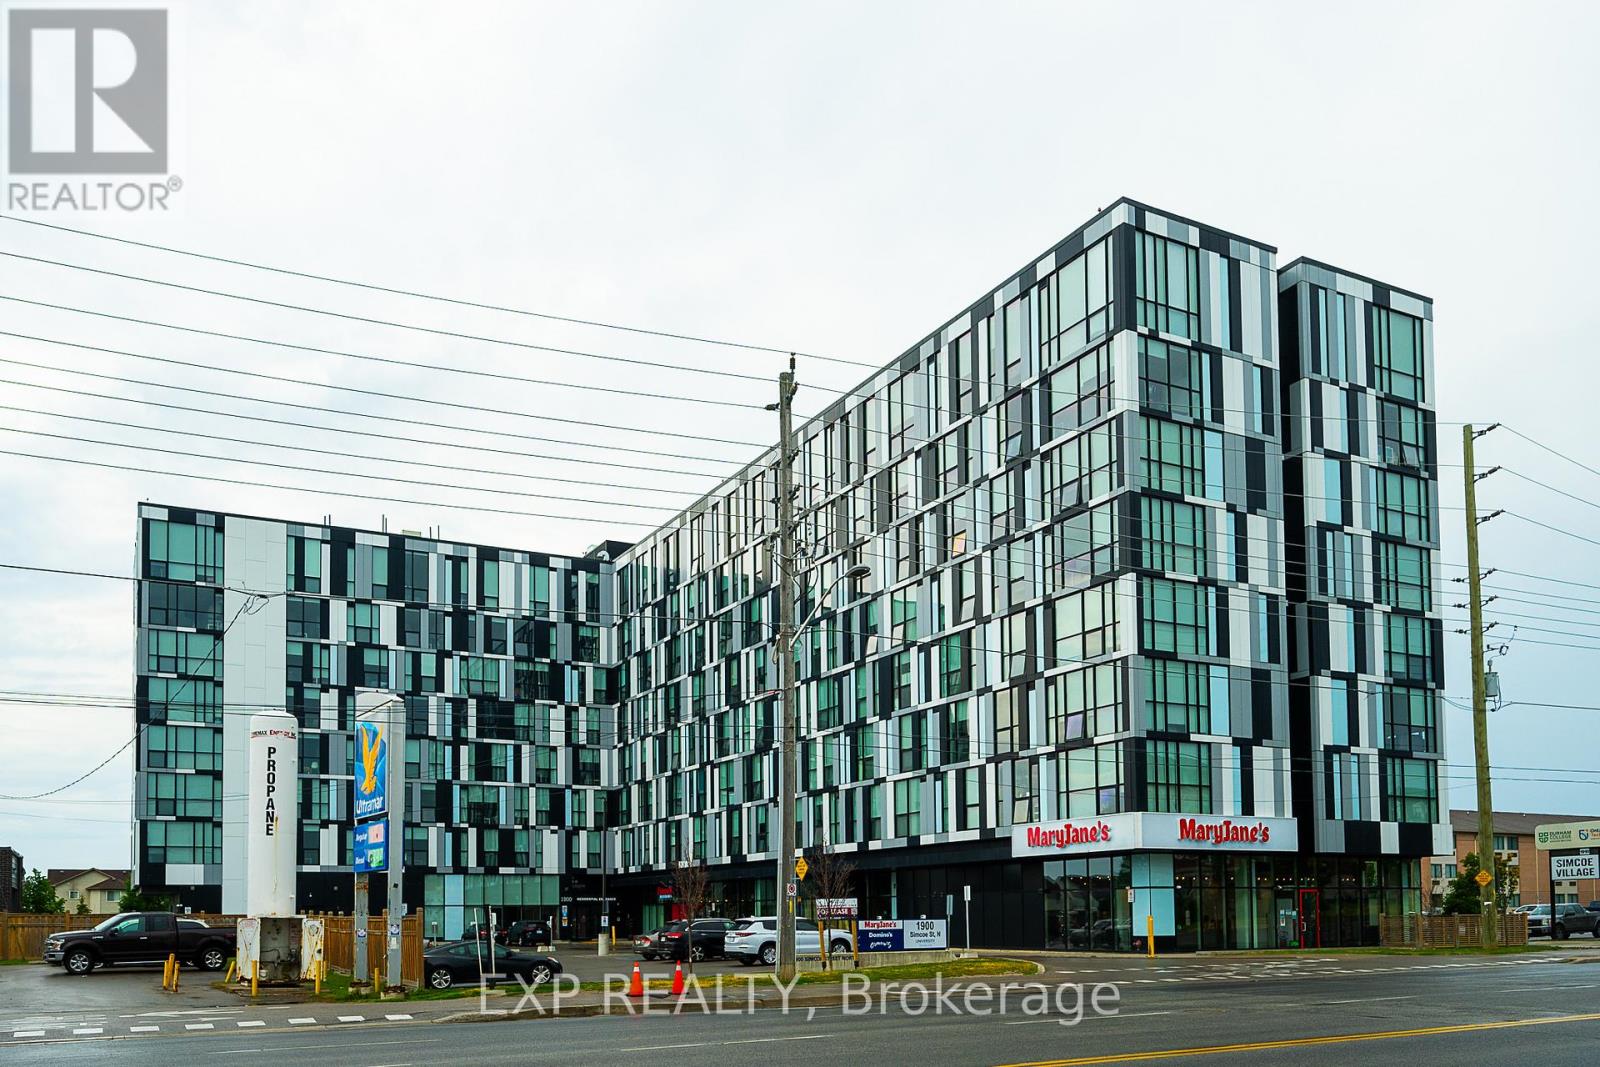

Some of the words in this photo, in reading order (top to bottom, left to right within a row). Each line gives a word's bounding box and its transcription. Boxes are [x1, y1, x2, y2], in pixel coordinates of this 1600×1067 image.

[265, 746, 276, 836] PROPANE
[356, 796, 383, 814] Ultramar
[1027, 820, 1110, 848] MaryJane's
[1178, 818, 1270, 845] MaryJane's
[1556, 857, 1593, 868] SIMCOE
[1556, 867, 1595, 877] VILLAGE
[864, 921, 897, 929] MaryJane's
[916, 921, 934, 930] 1900
